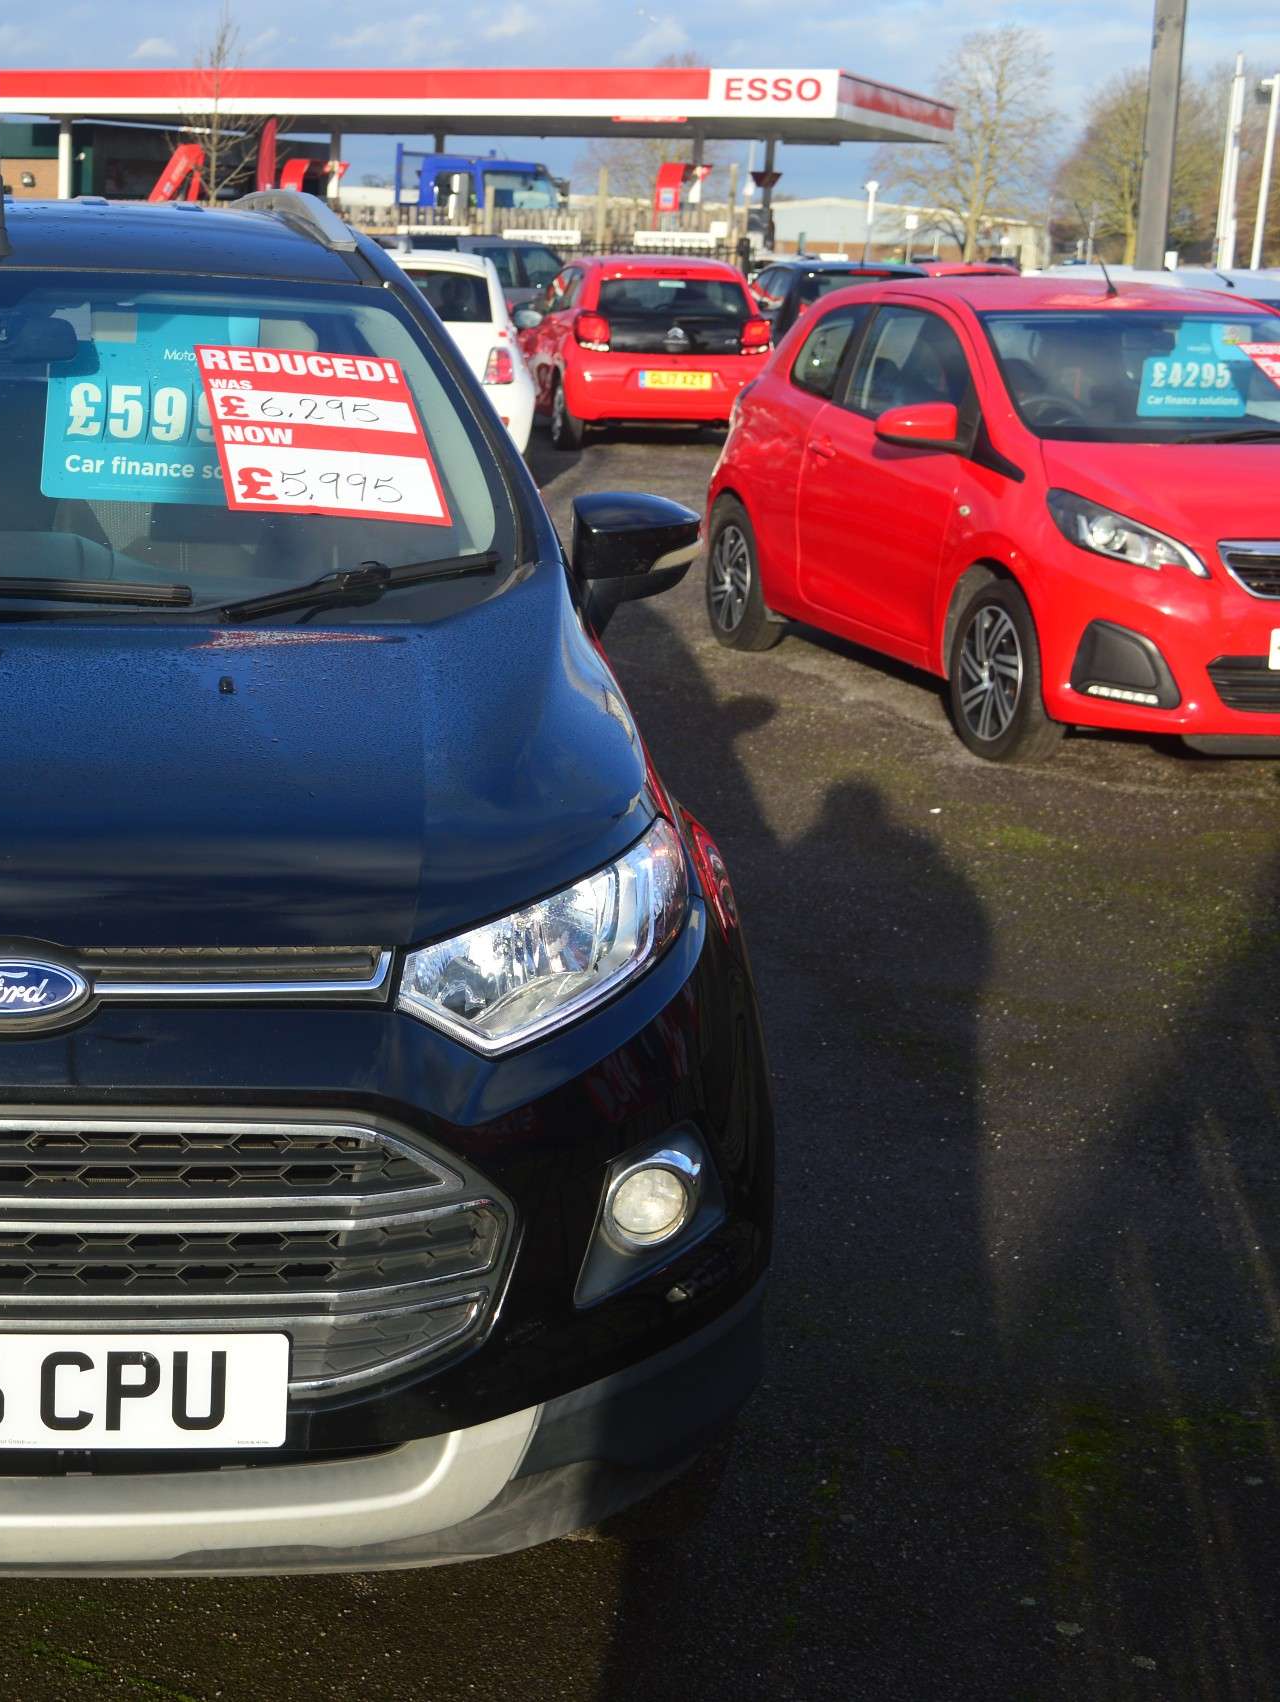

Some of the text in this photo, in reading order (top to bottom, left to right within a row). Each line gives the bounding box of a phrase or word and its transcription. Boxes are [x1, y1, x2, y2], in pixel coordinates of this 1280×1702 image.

[724, 77, 822, 102] ESSO
[163, 348, 197, 362] Moto
[199, 348, 400, 384] REDUCED!
[209, 378, 253, 391] WAS
[1151, 361, 1232, 389] £4295
[220, 425, 294, 446] NOW
[64, 454, 105, 474] Car
[111, 456, 195, 478] finance
[39, 1350, 227, 1432] CPU
